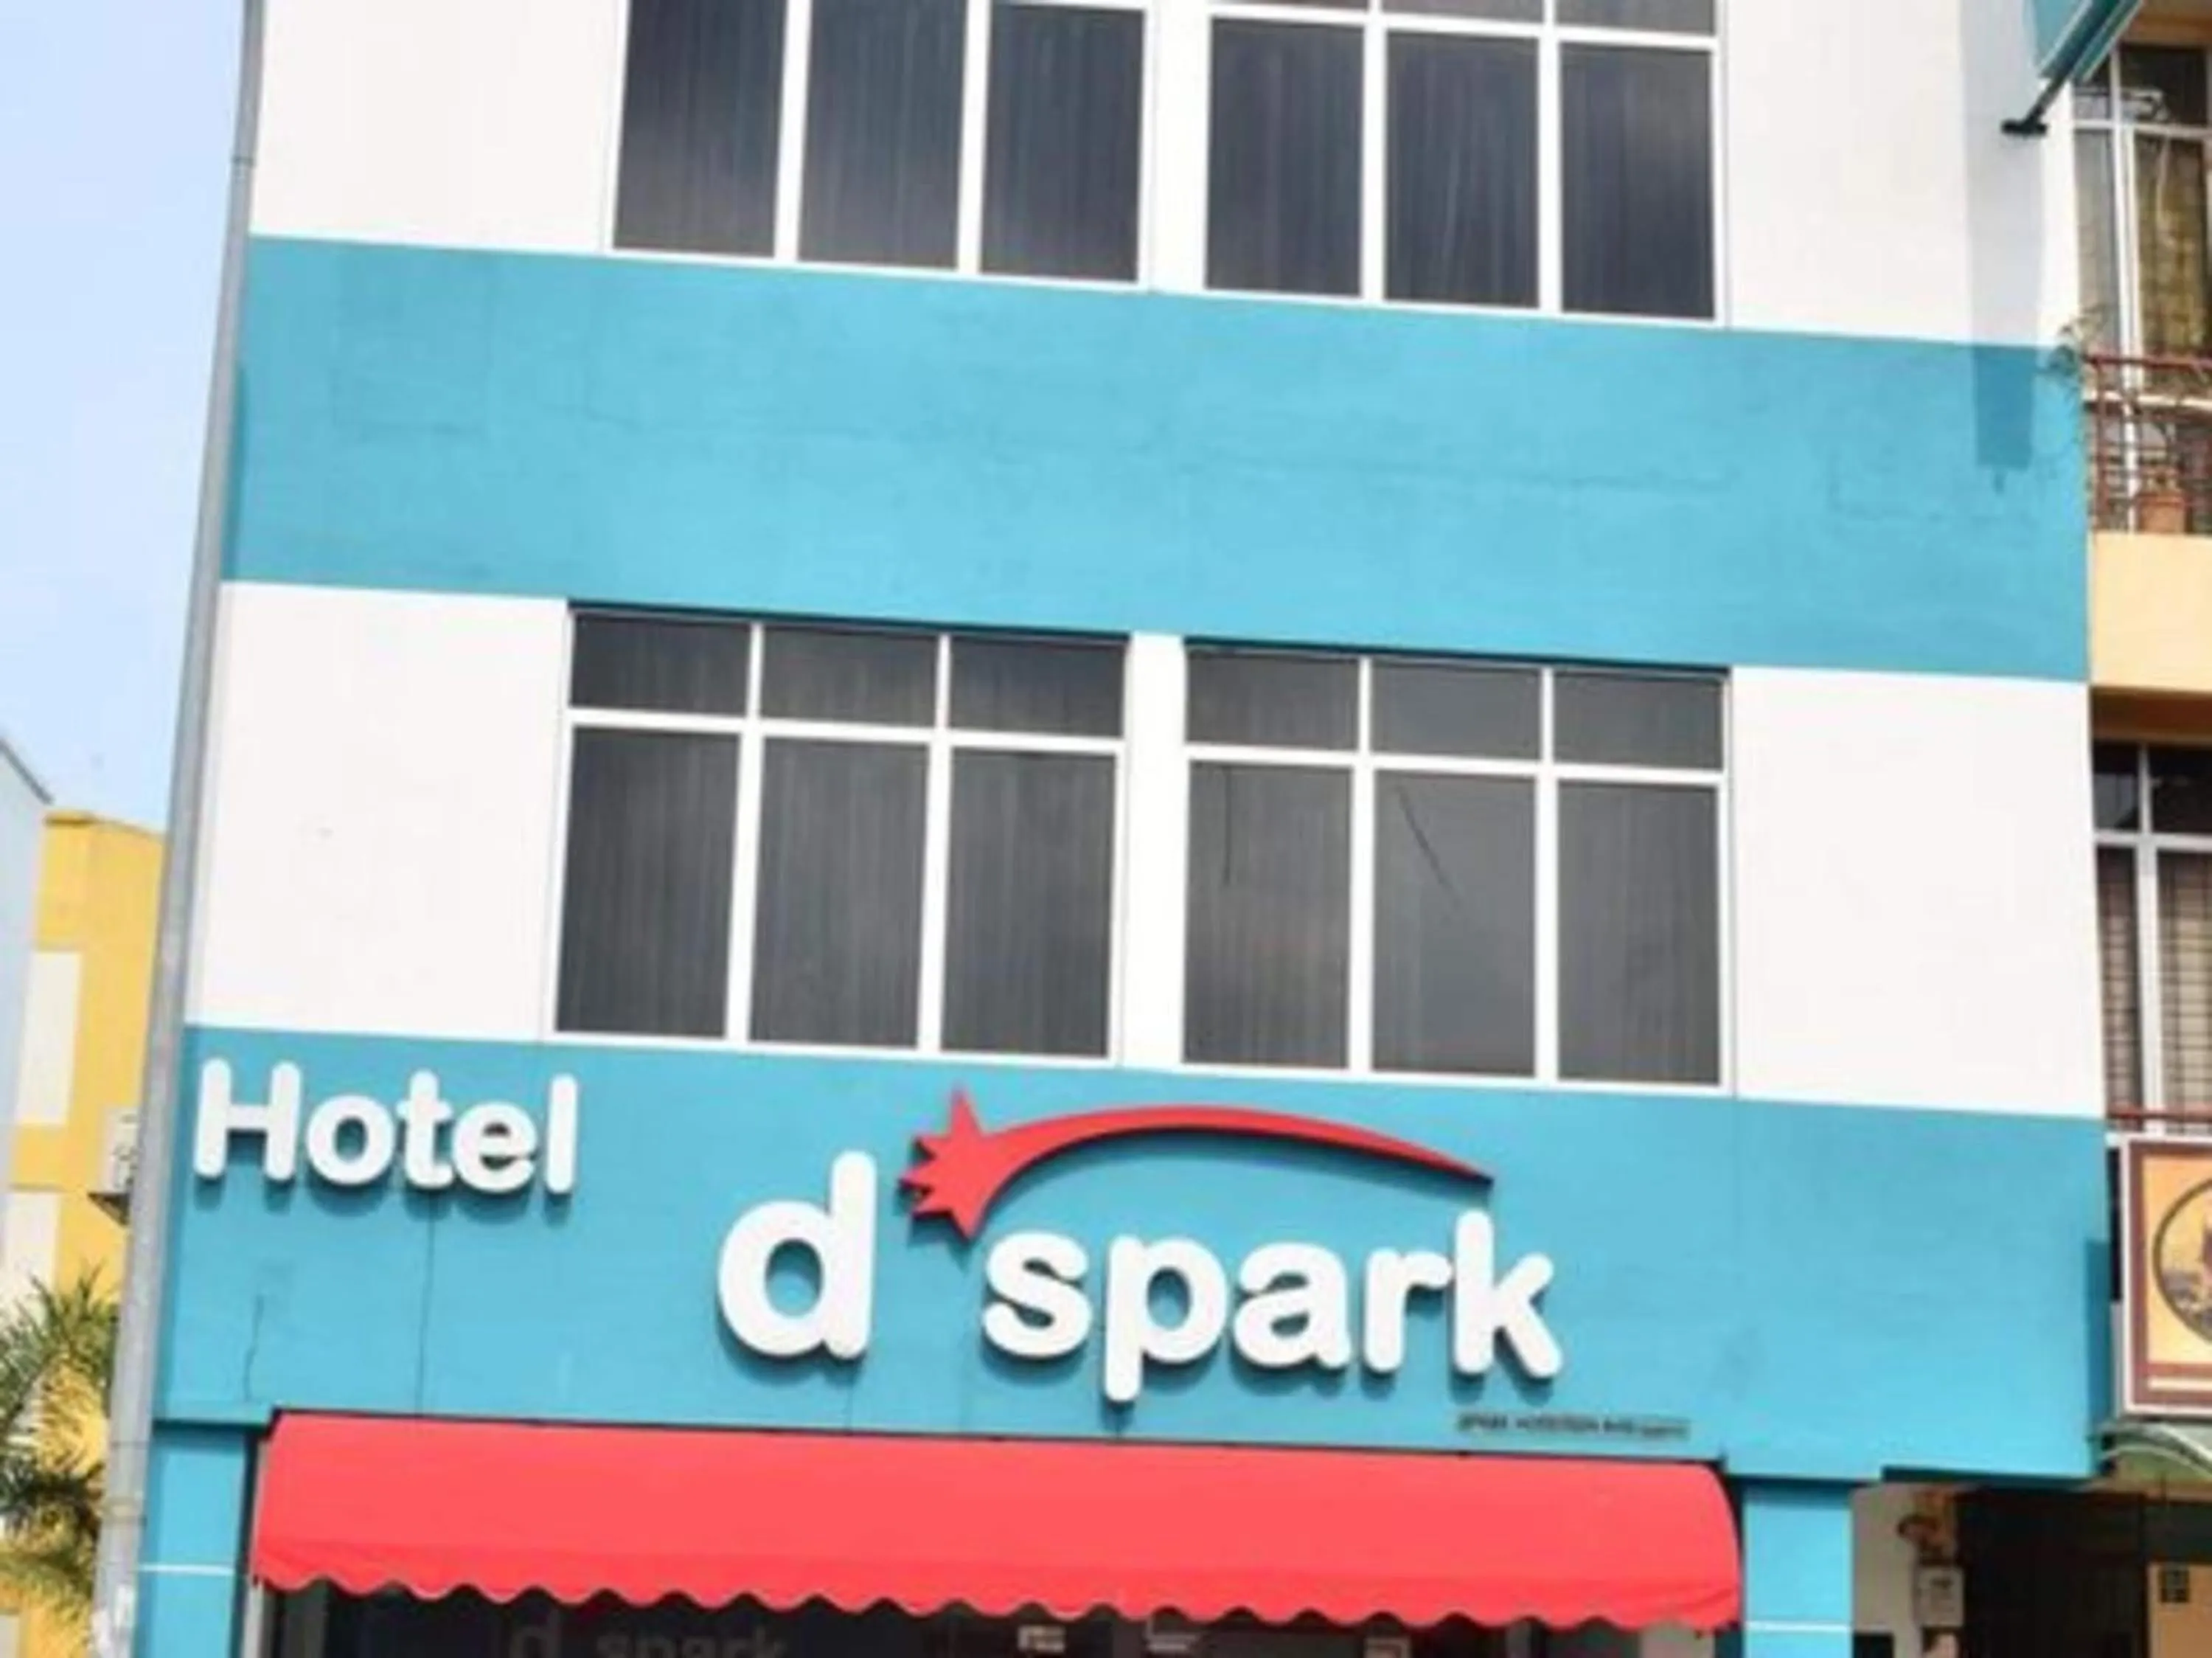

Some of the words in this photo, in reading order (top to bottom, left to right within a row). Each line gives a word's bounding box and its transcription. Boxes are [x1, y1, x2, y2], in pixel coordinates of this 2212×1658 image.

[195, 1059, 579, 1193] Hotel
[718, 1151, 877, 1359] d
[984, 1210, 1563, 1404] spark
